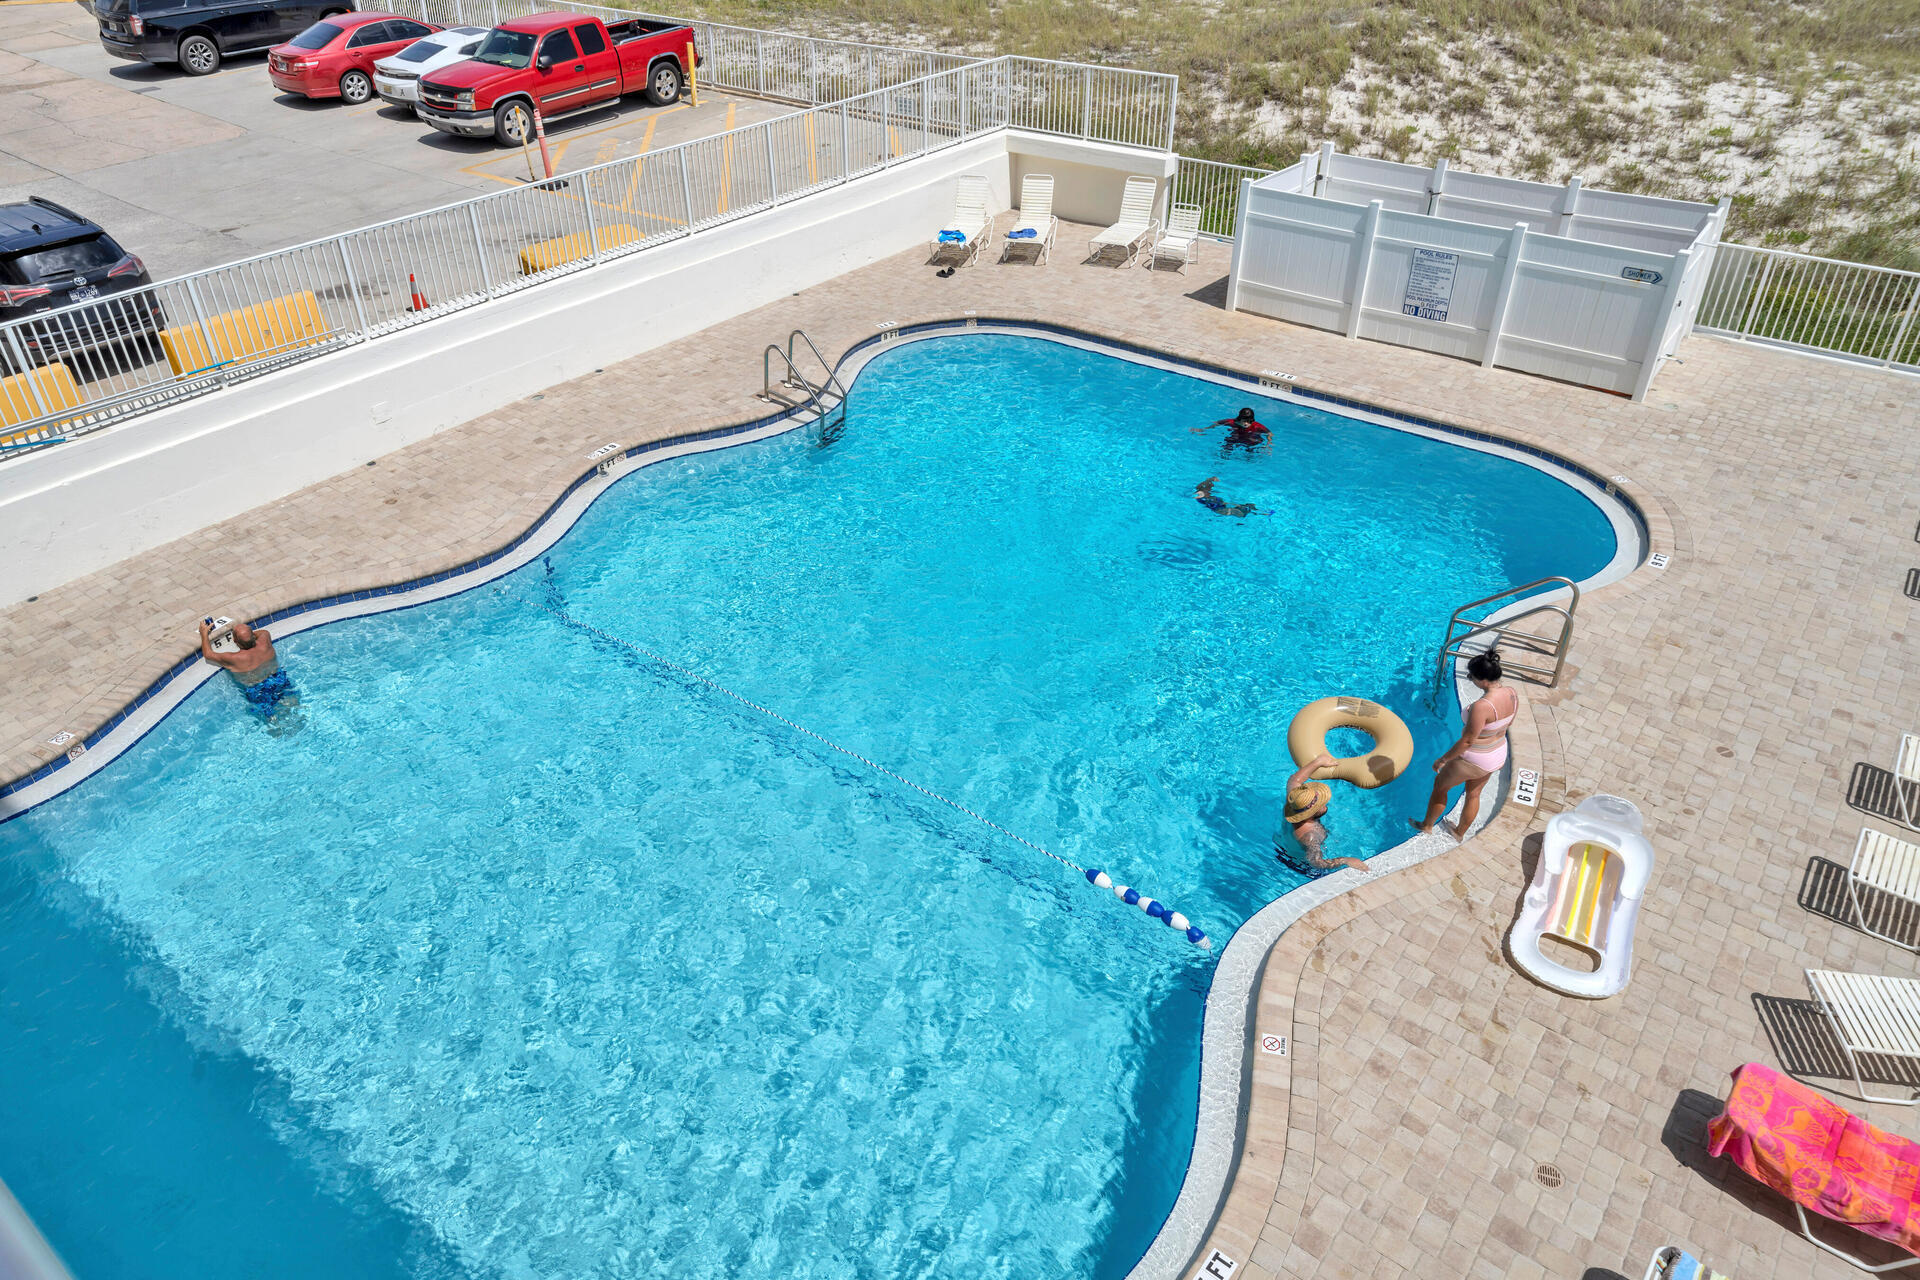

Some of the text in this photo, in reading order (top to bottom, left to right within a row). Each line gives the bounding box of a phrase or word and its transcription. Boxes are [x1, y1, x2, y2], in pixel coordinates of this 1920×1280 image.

[1420, 249, 1453, 260] POOL RULES
[1627, 270, 1652, 280] SHOWER
[1434, 299, 1448, 307] DEPTH
[1403, 304, 1447, 321] NO DIVING
[607, 457, 616, 468] FT
[1654, 553, 1667, 563] FT
[213, 638, 222, 649] 5
[1516, 780, 1535, 802] 6 FT
